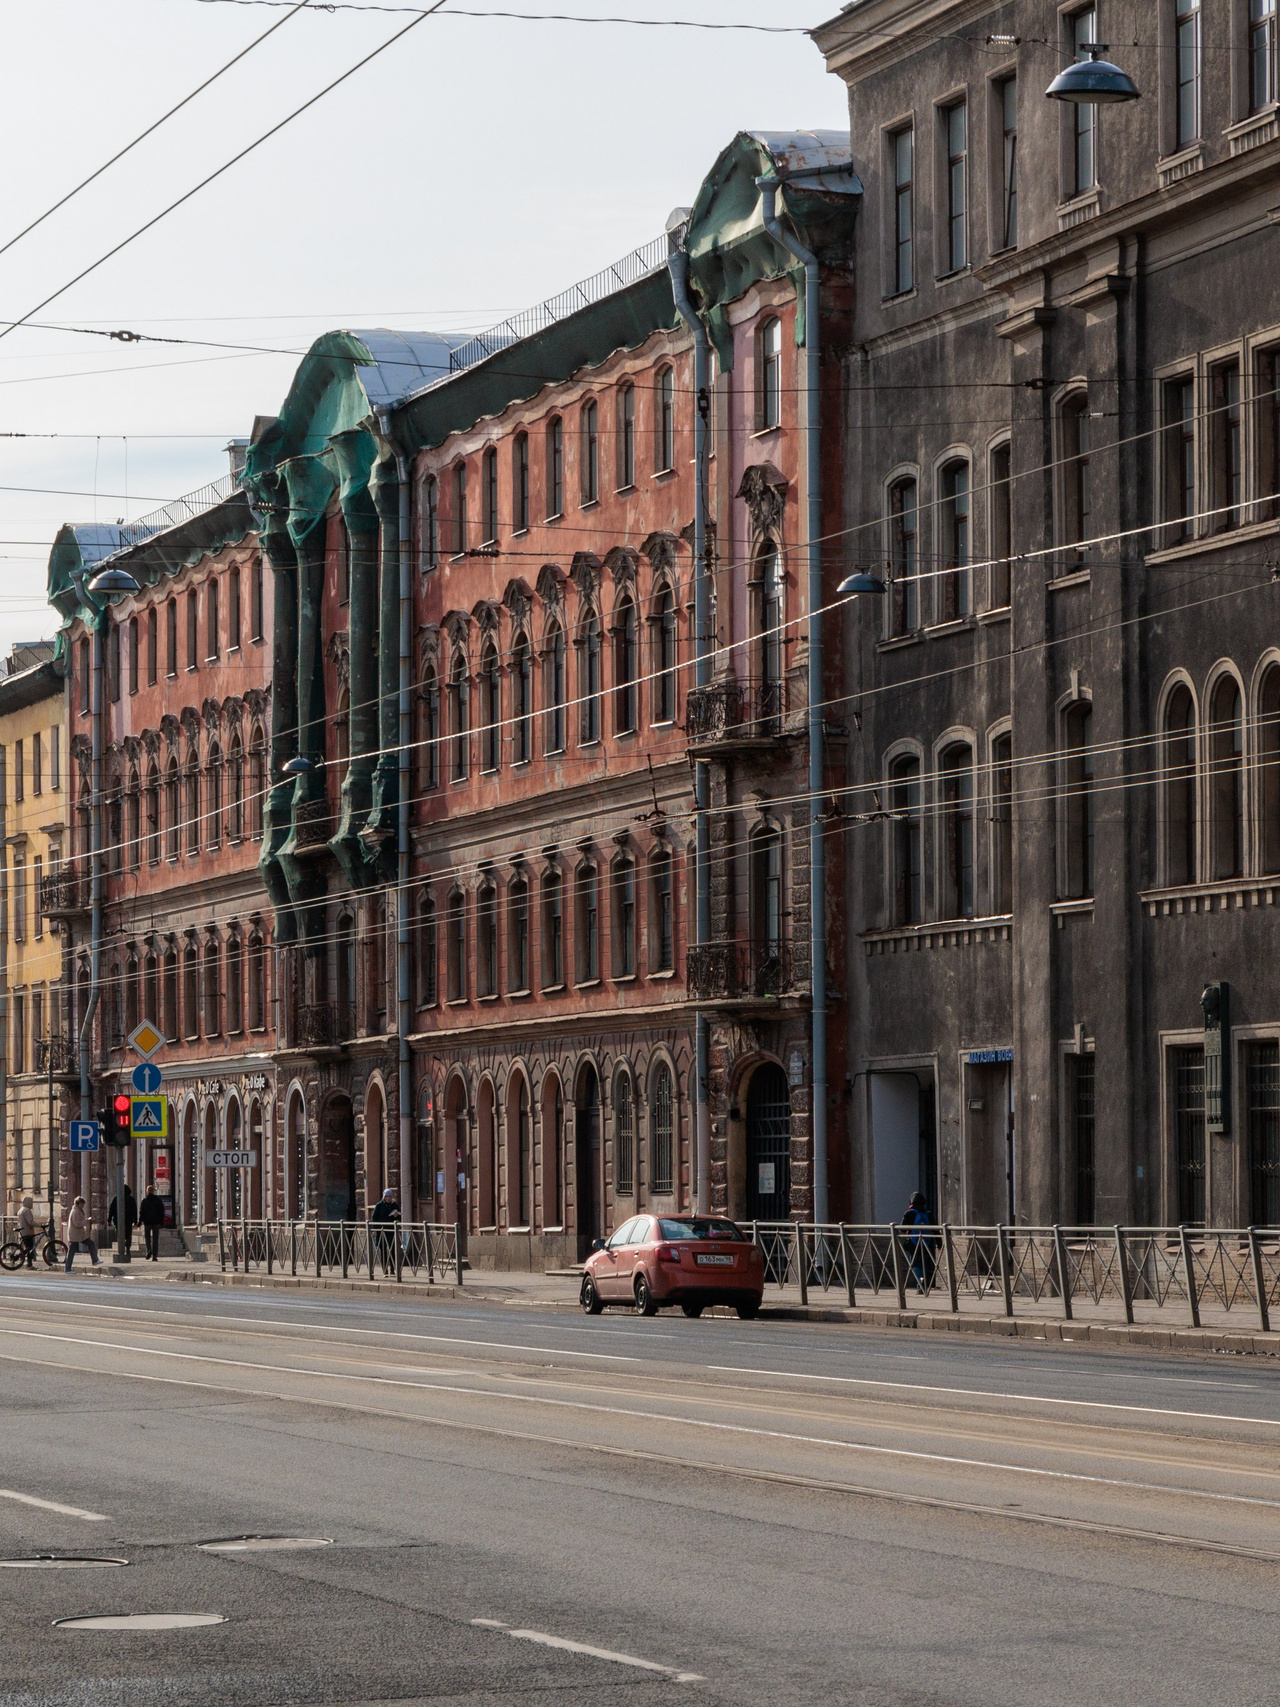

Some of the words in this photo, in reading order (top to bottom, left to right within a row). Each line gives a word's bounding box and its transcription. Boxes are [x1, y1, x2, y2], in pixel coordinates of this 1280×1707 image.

[969, 1051, 995, 1063] МАГАЗИН
[78, 1125, 94, 1147] P
[213, 1153, 249, 1164] СТОП
